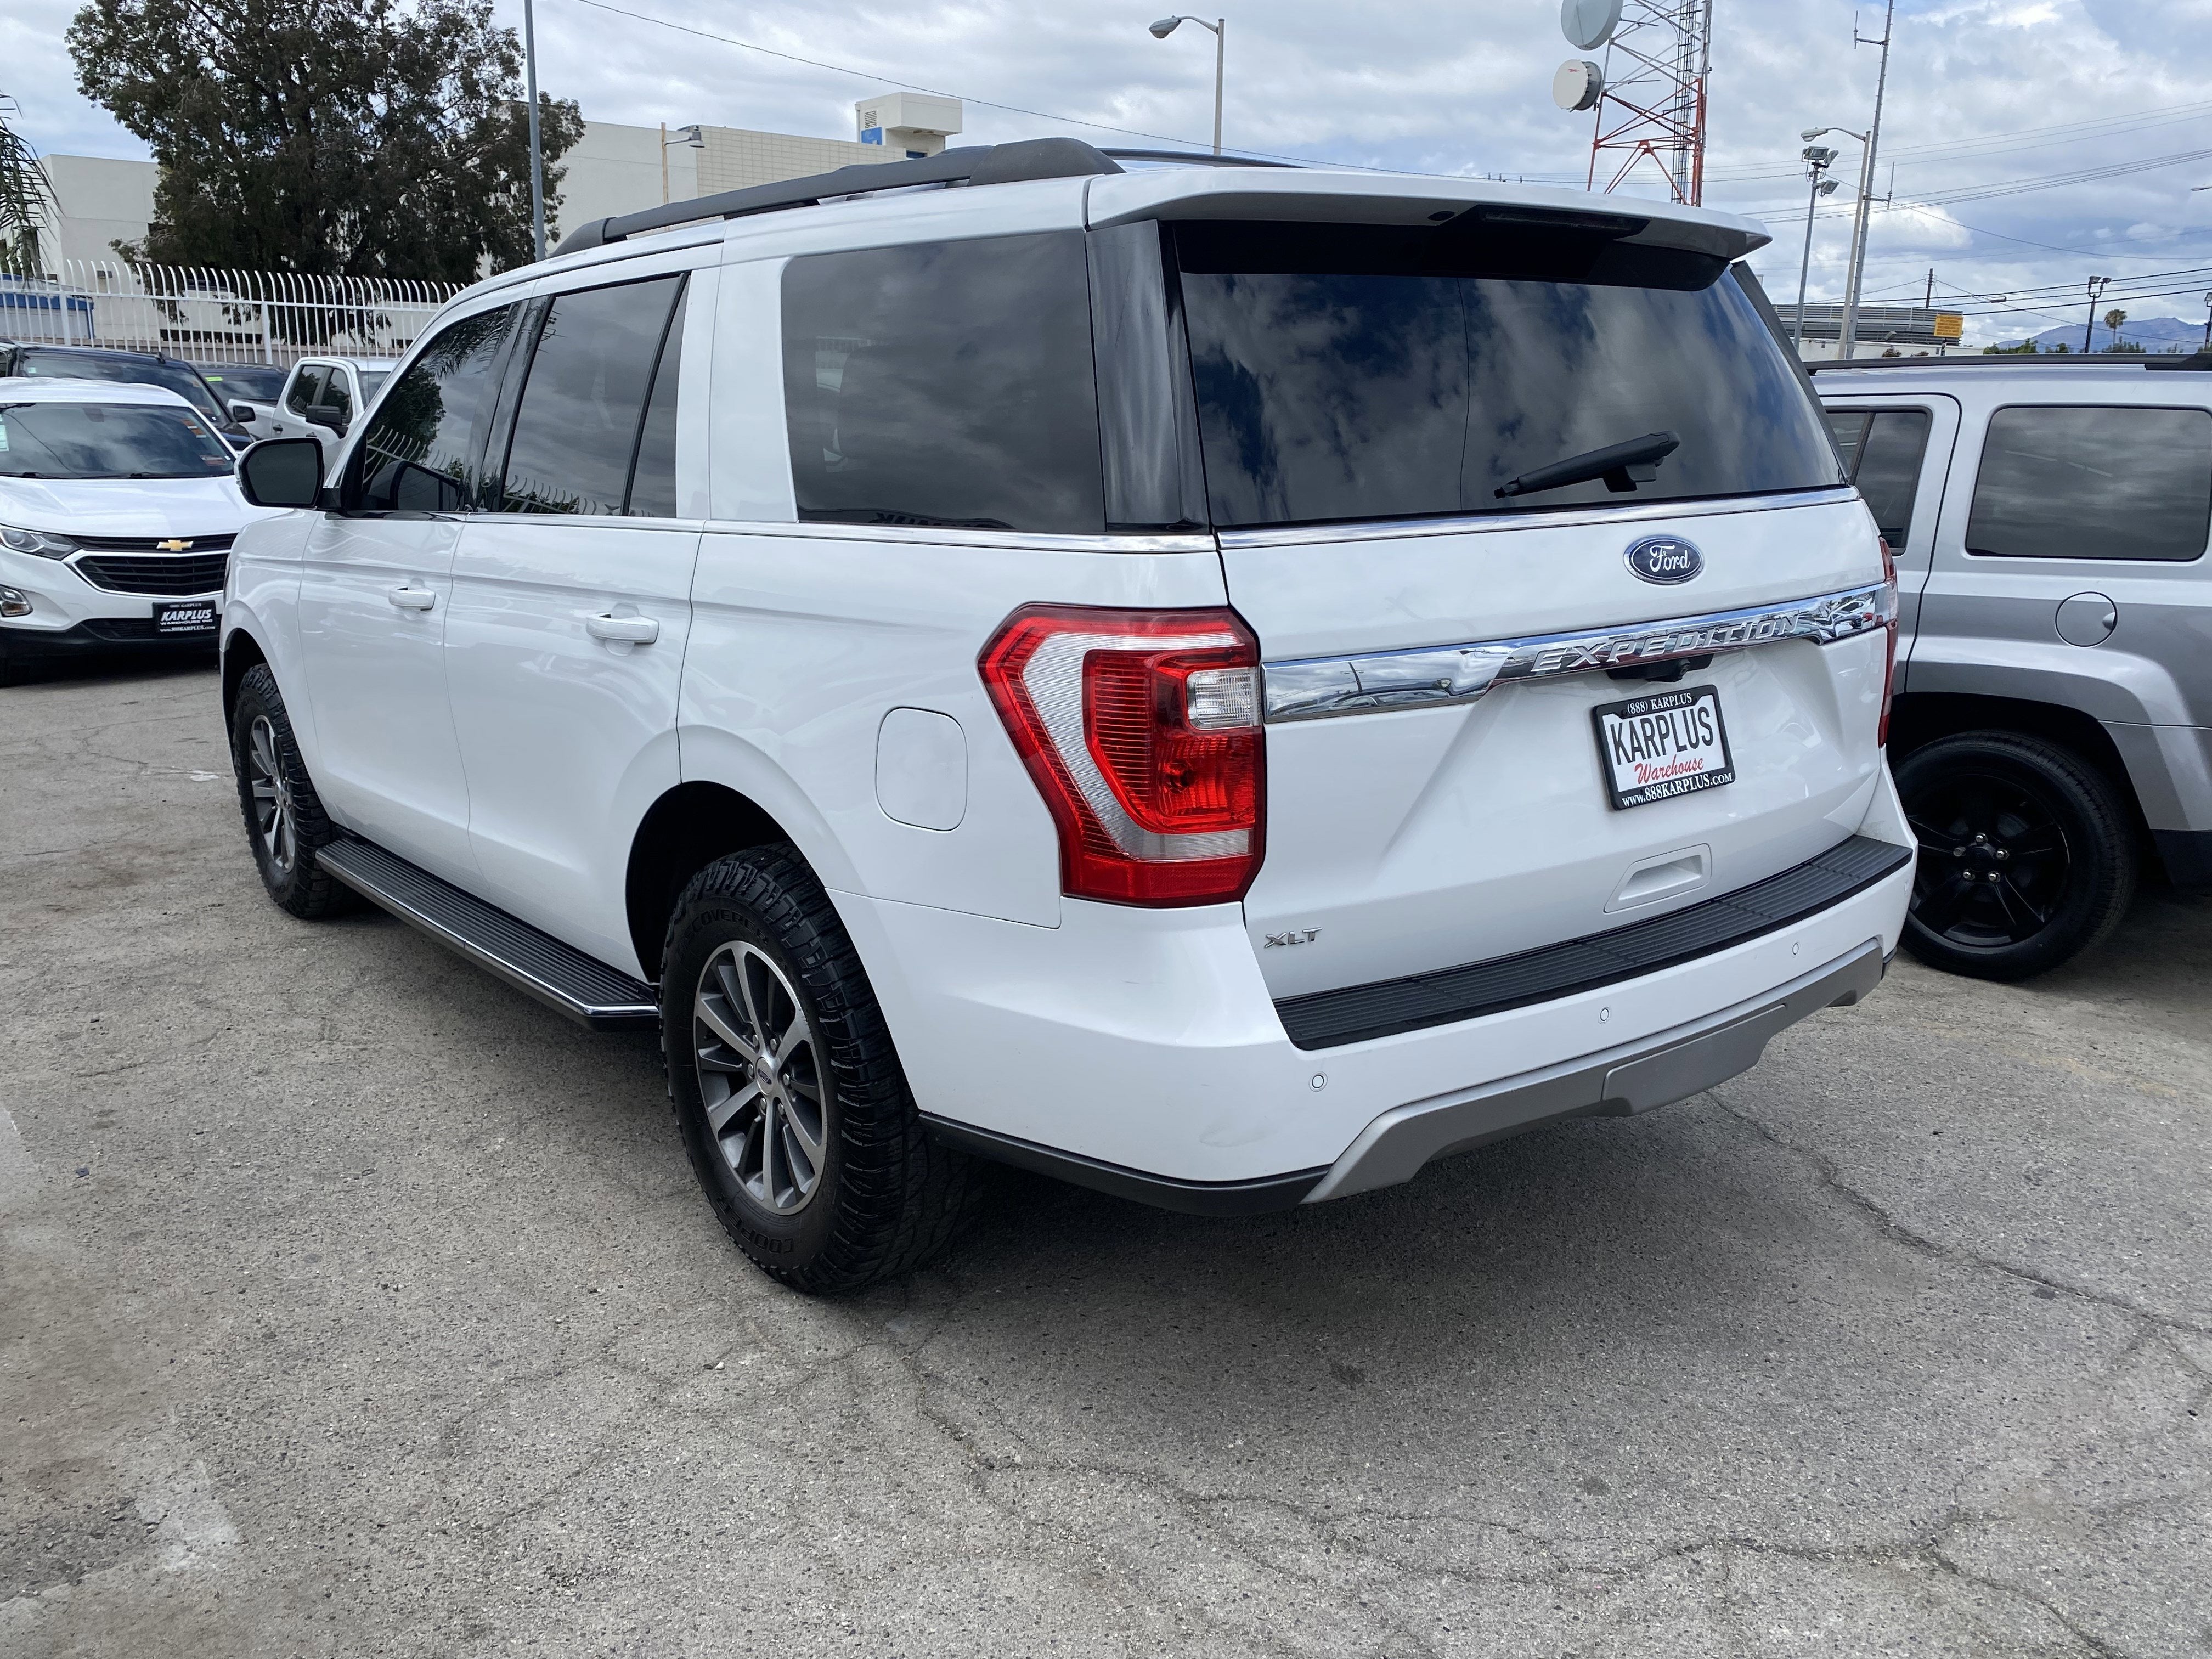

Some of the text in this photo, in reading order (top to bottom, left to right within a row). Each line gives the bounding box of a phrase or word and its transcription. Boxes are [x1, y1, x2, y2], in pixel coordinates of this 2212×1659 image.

[1649, 545, 1691, 572] Ford
[160, 609, 212, 622] KARPLUS
[1530, 611, 1801, 673] EXPEDITION
[1627, 692, 1692, 714] (888) KARPLUS
[1610, 706, 1714, 765] KARPLUS
[1634, 754, 1704, 785] Warehouse
[1264, 927, 1323, 949] XLT
